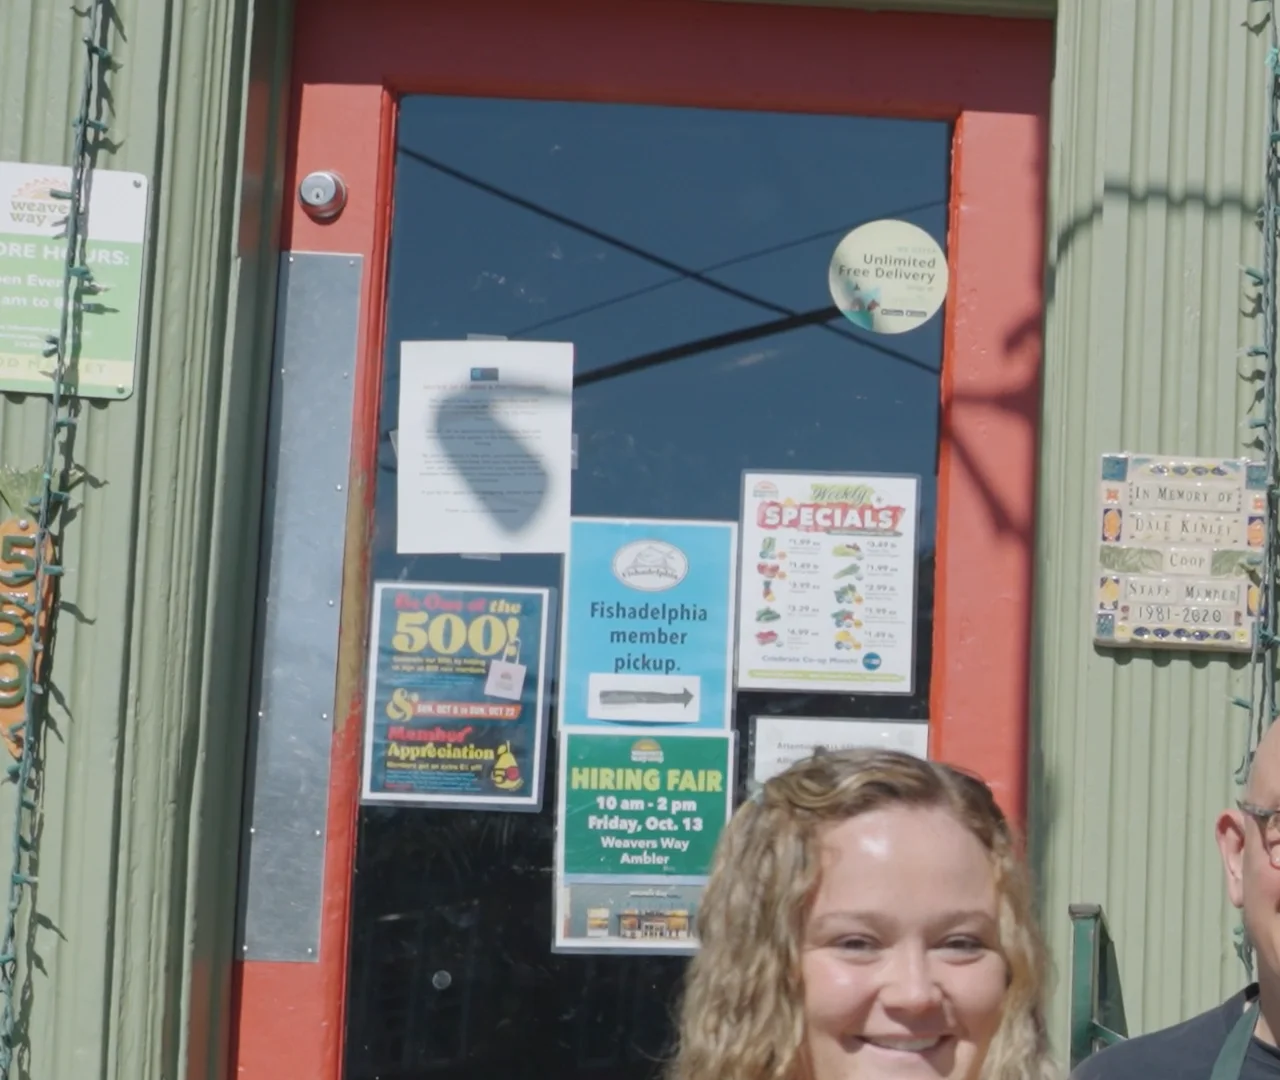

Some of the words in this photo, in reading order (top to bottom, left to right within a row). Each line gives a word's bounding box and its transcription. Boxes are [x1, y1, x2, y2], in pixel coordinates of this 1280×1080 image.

[43, 245, 130, 266] HURS:
[863, 253, 937, 269] Unlimited
[838, 264, 870, 277] Free
[875, 267, 936, 285] Delivery
[1134, 486, 1151, 500] IN
[1157, 487, 1209, 503] MEMORY
[1218, 491, 1234, 503] OF
[766, 505, 893, 529] SPECIALS
[1134, 518, 1171, 532] DALE
[489, 599, 522, 614] the
[589, 601, 708, 626] Fishadelphia
[1137, 606, 1222, 623] 1981-2020
[391, 611, 520, 657] 500!
[609, 627, 689, 645] member
[613, 652, 681, 674] pickup.
[387, 725, 473, 742] Member
[387, 742, 495, 761] Appreciation
[570, 766, 661, 791] HIRING
[666, 769, 724, 793] FAIR
[596, 796, 617, 811] 10
[620, 798, 645, 811] am
[656, 797, 668, 811] 2
[671, 799, 697, 815] pm
[587, 815, 642, 833] Friday,
[645, 817, 678, 832] Oct.
[682, 817, 704, 832] 13
[600, 835, 658, 850] Weavers
[660, 837, 690, 852] Way
[620, 850, 670, 865] Ambler
